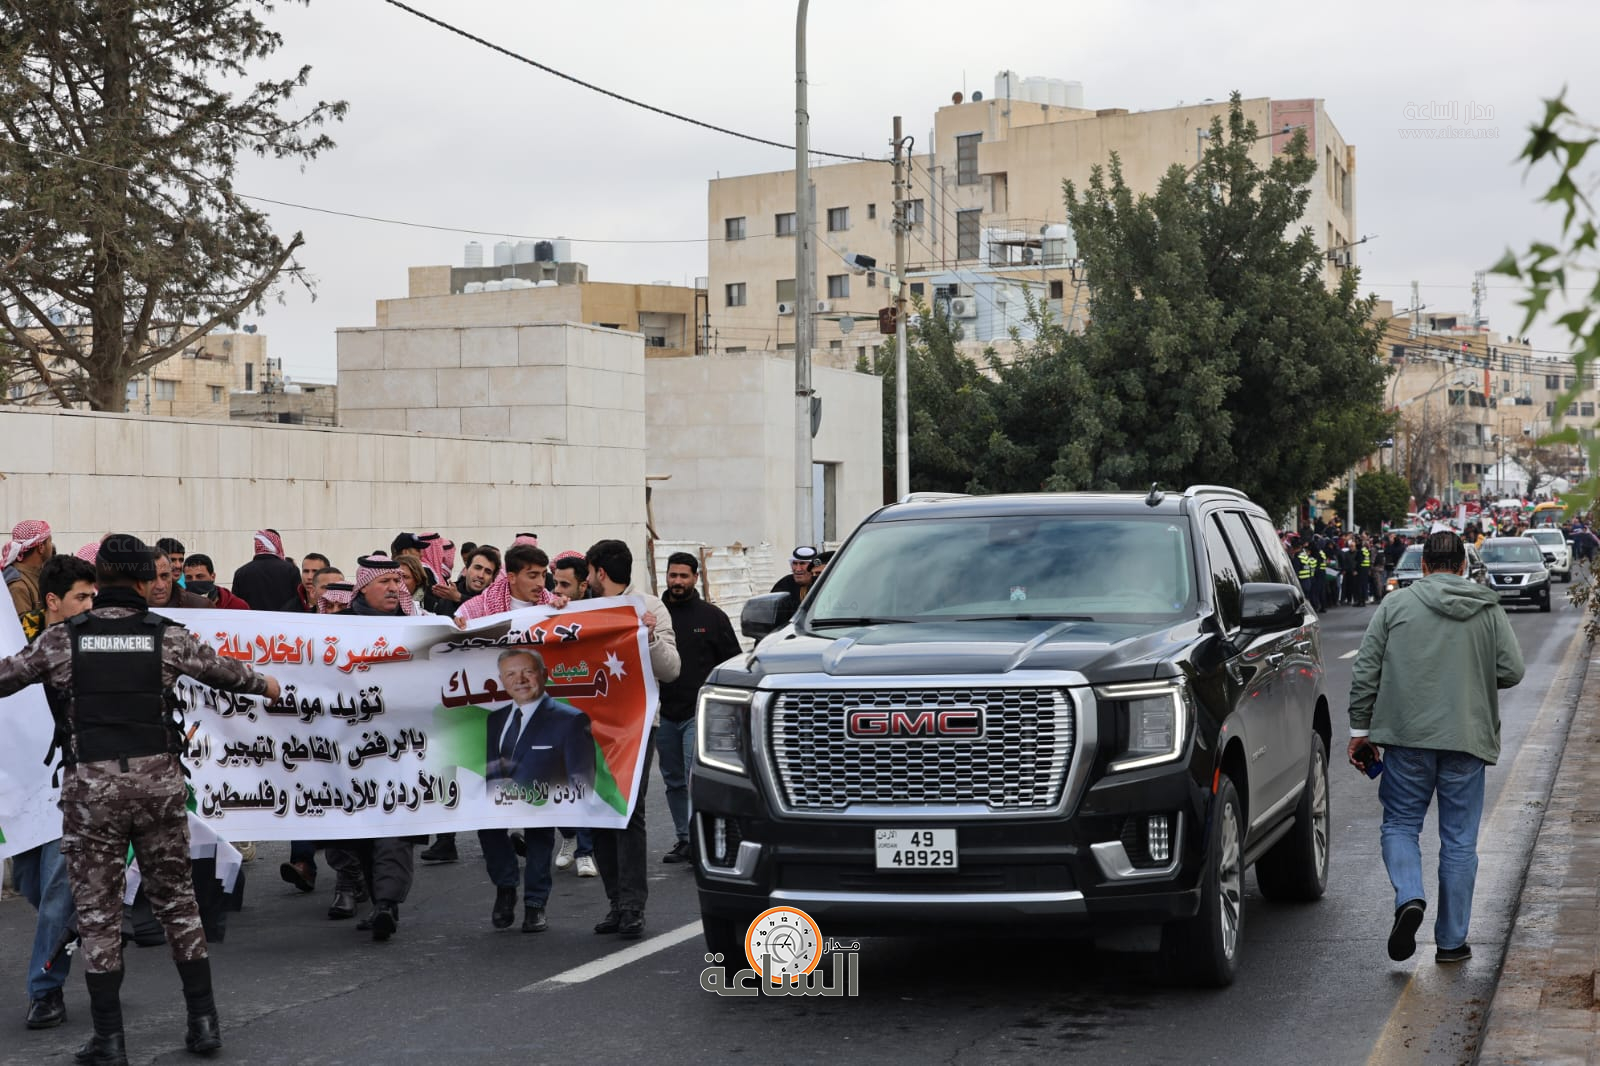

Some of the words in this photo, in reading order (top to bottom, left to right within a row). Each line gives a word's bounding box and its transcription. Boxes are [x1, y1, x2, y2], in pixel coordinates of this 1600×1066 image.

[81, 636, 152, 650] GENDARMERIE
[553, 623, 583, 642] لا
[322, 635, 413, 673] عشيرة
[552, 660, 590, 682] شعبك
[263, 684, 324, 723] موقف
[330, 685, 384, 726] تؤيد
[851, 711, 979, 736] GMC
[216, 735, 275, 767] لتهجير
[282, 735, 340, 771] القاطع
[348, 728, 426, 769] بالرفض
[202, 779, 289, 818] وفلسطين
[294, 778, 378, 816] للأردنيين
[383, 769, 460, 814] والأردن
[910, 831, 934, 847] 49
[892, 850, 954, 866] 48929
